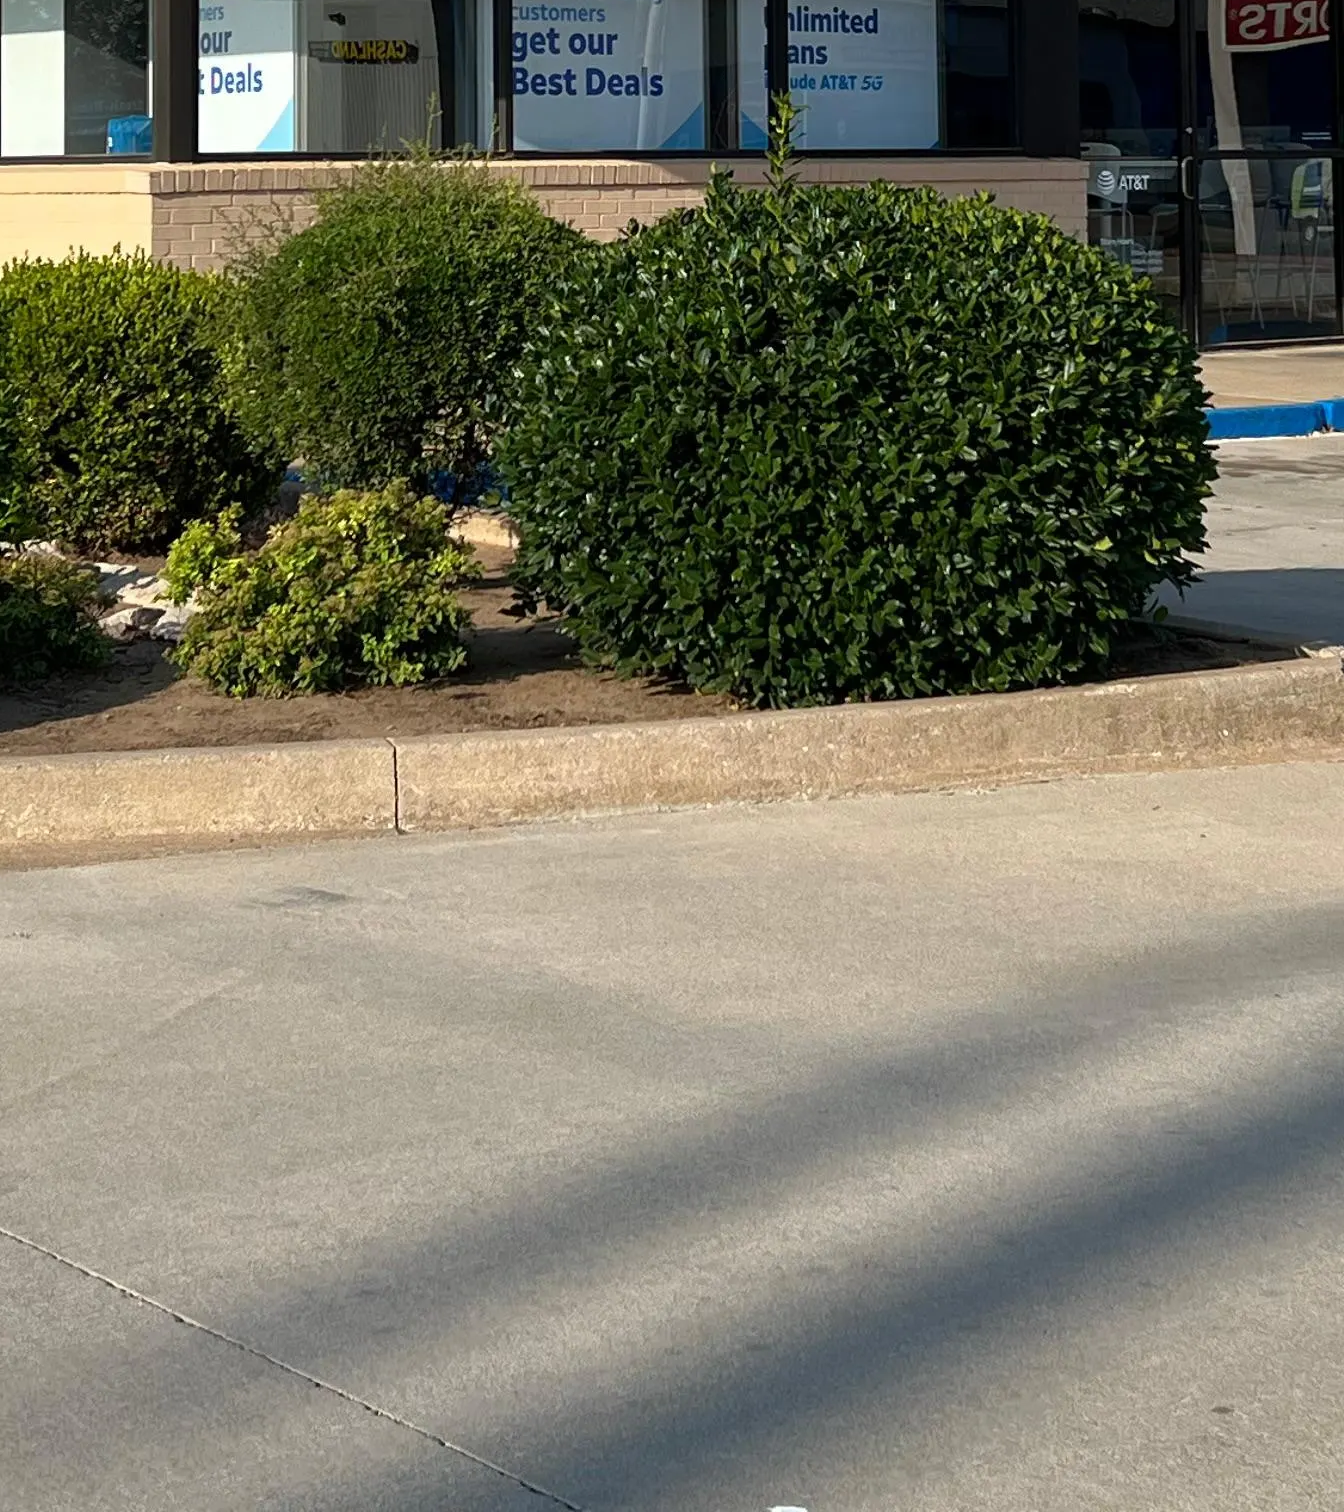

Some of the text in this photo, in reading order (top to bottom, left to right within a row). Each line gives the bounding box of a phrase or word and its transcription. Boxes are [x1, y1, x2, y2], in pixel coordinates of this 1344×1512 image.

[764, 6, 878, 34] nlimited
[201, 31, 232, 54] our
[512, 28, 618, 62] get our
[211, 63, 263, 94] Deals
[512, 67, 664, 96] Best Deals
[820, 74, 857, 90] AT&T
[861, 75, 883, 91] 5G
[1118, 175, 1150, 190] AT&T
